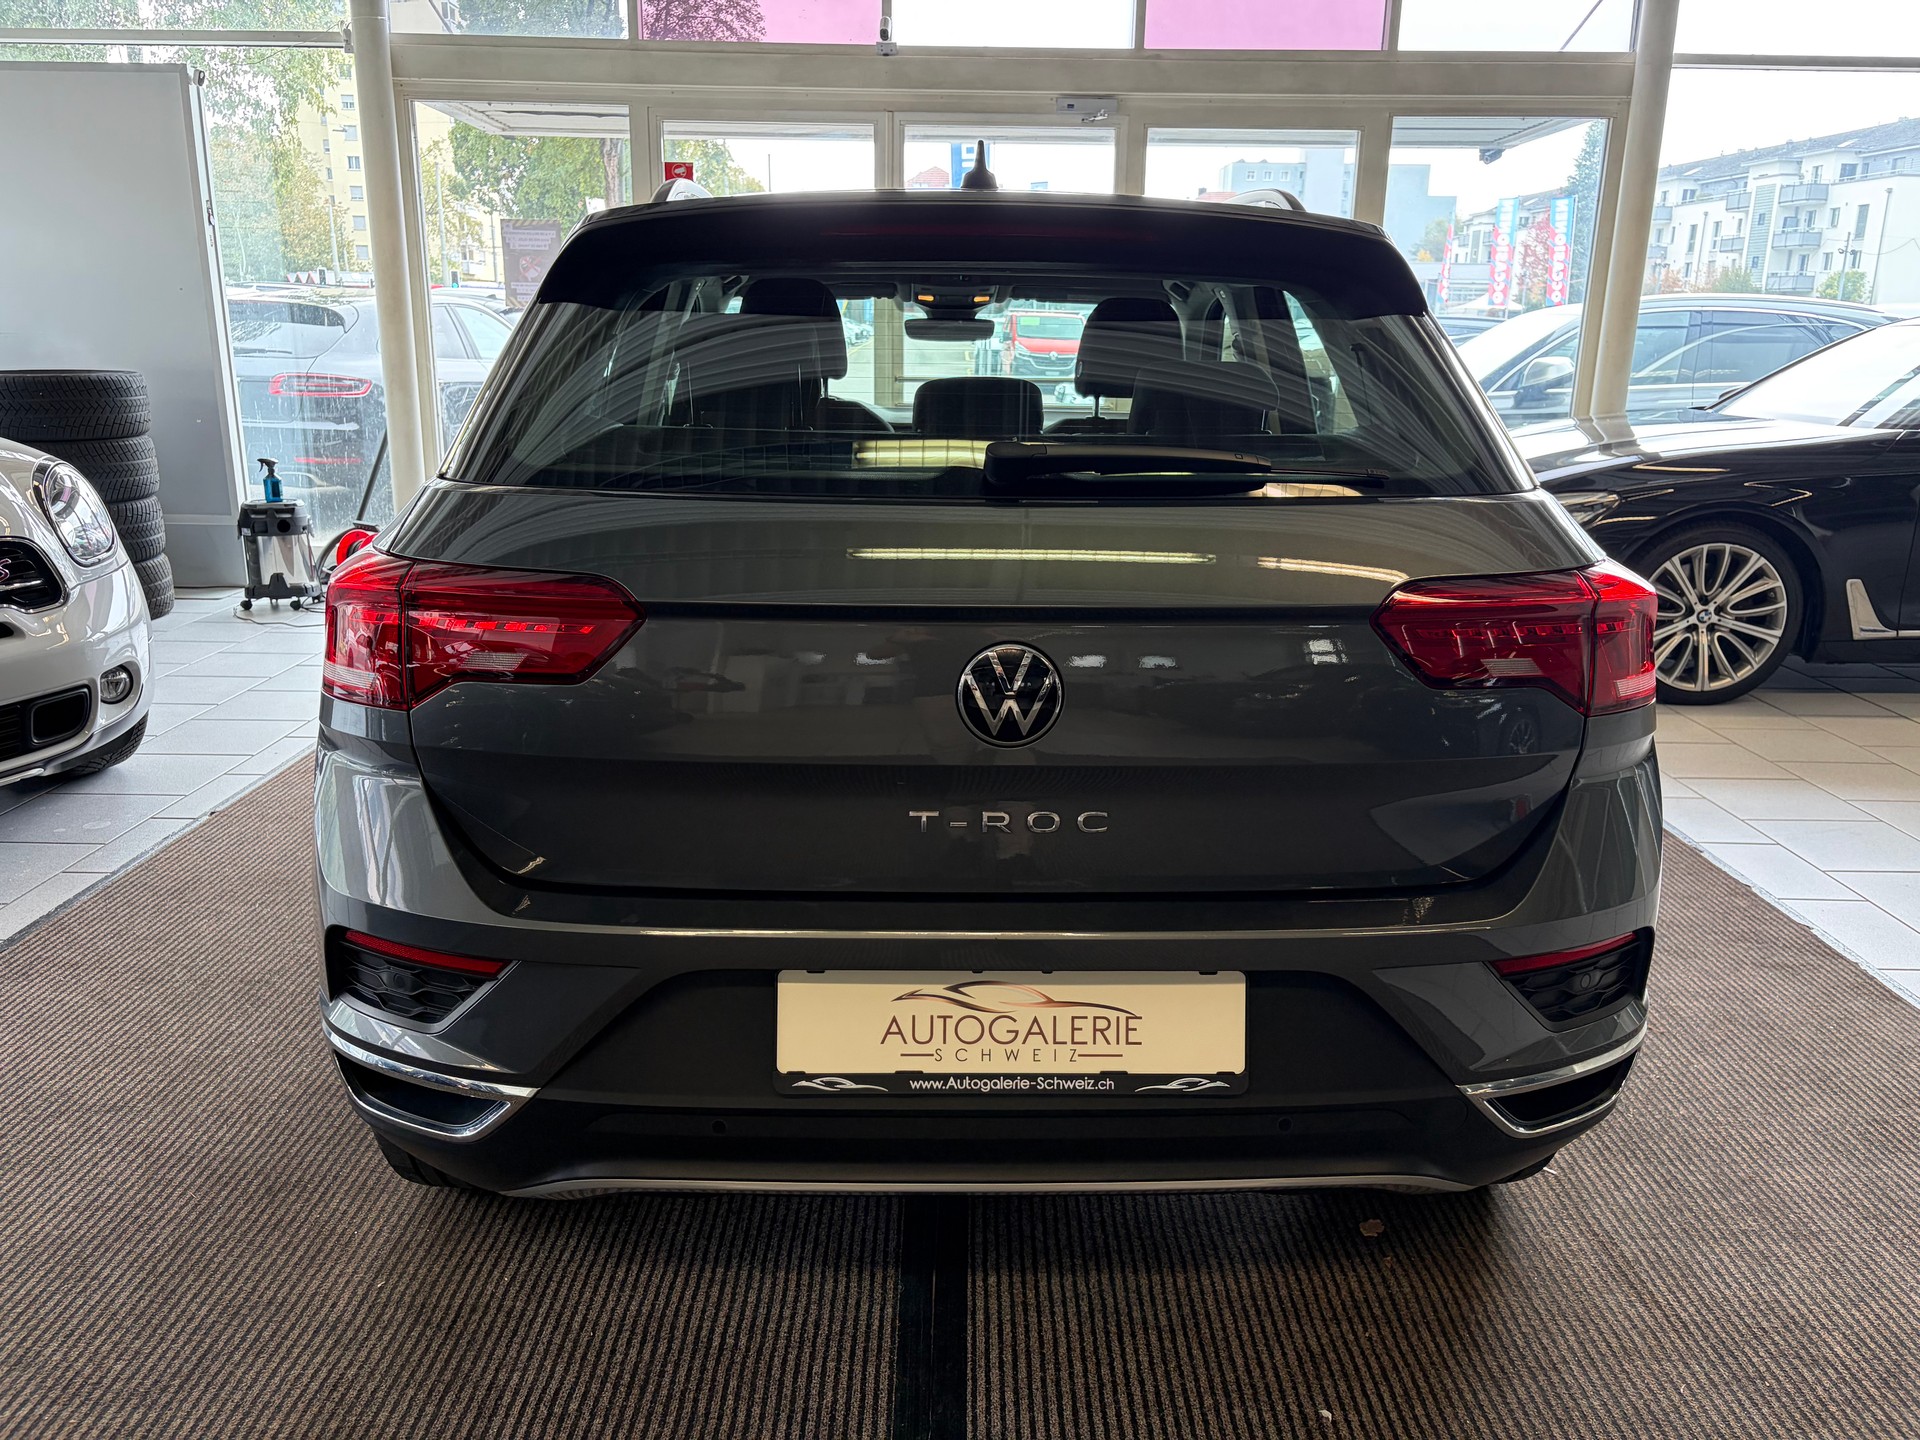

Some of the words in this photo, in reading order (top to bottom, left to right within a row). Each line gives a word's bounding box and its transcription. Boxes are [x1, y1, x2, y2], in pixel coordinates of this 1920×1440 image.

[908, 810, 1108, 833] T-ROC
[880, 1015, 1143, 1046] AUTOGALERIE
[934, 1048, 1079, 1063] SCHWEIZ
[909, 1076, 1115, 1092] www.Autogalerie-Schweiz.ch
